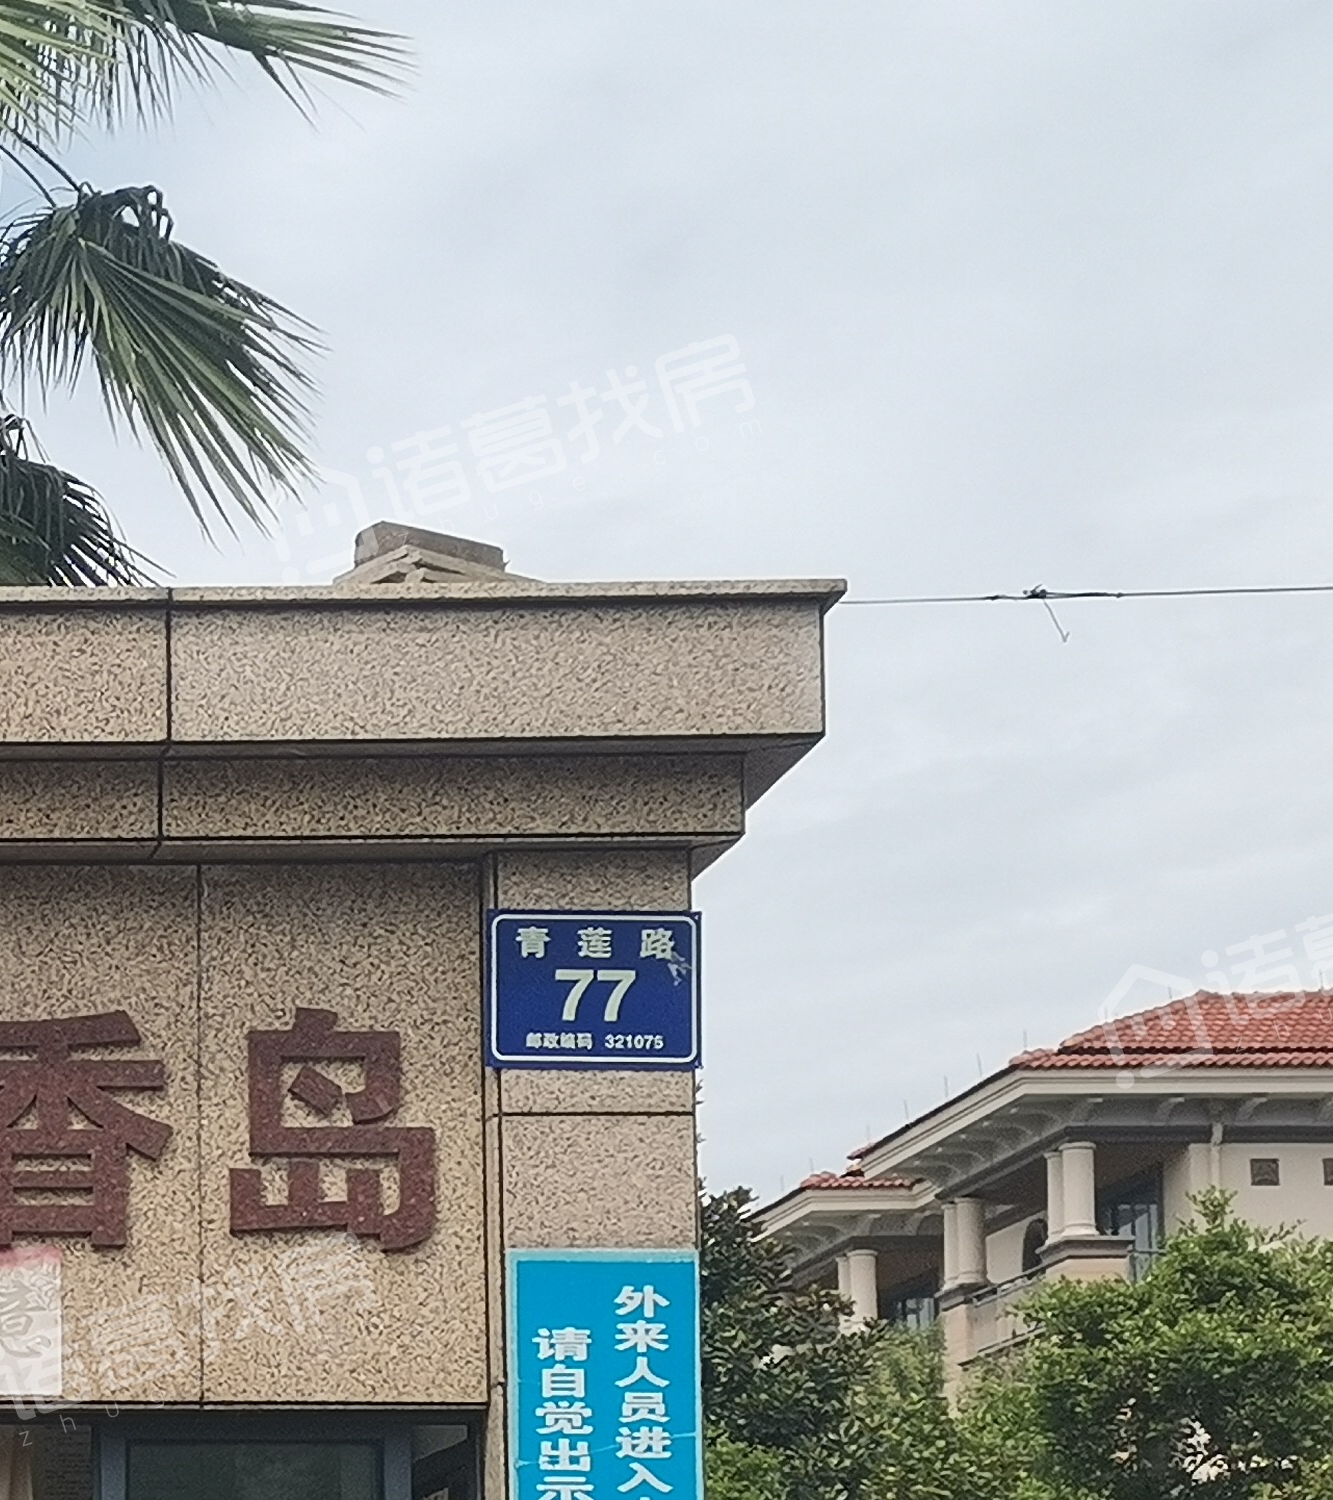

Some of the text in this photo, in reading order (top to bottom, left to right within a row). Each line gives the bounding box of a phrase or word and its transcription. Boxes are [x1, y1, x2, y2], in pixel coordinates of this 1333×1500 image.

[516, 927, 675, 959] 青莲路
[555, 969, 636, 1022] 77
[526, 1033, 664, 1050] 邮政编码 321075
